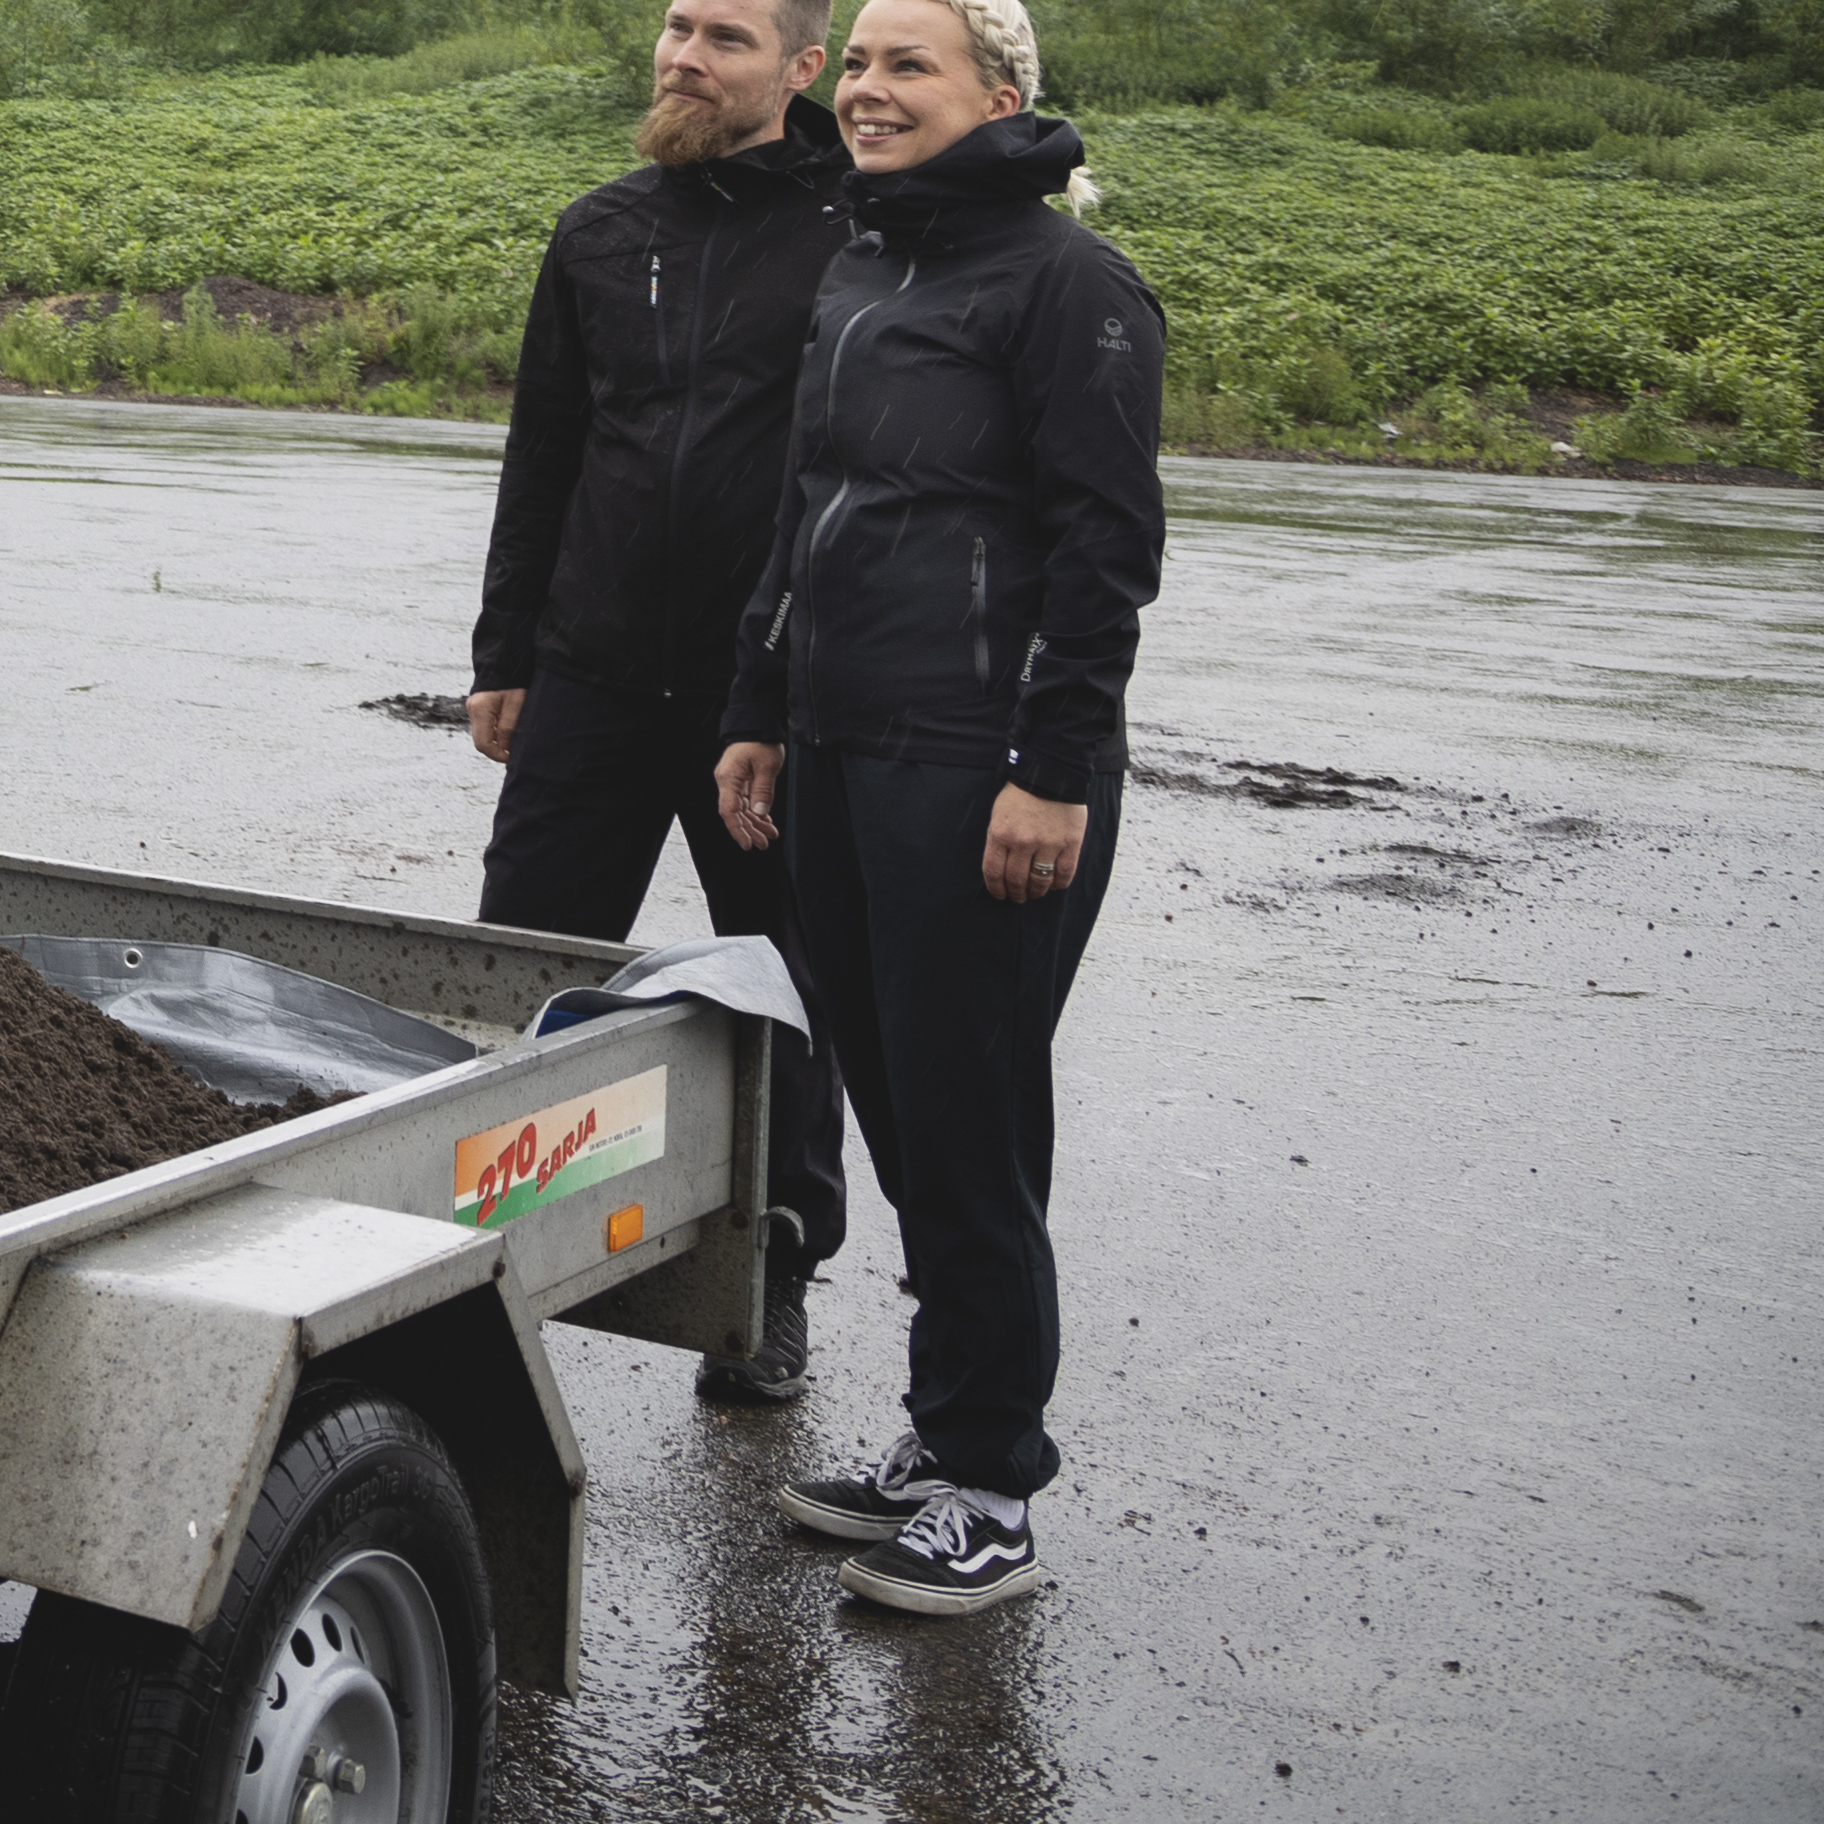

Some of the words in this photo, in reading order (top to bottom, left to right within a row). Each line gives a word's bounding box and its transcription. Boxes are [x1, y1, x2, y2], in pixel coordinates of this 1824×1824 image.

[1096, 336, 1132, 353] HALTI
[767, 591, 793, 644] KESKIMAA
[476, 1121, 538, 1227] 270
[536, 1107, 597, 1194] SARJA
